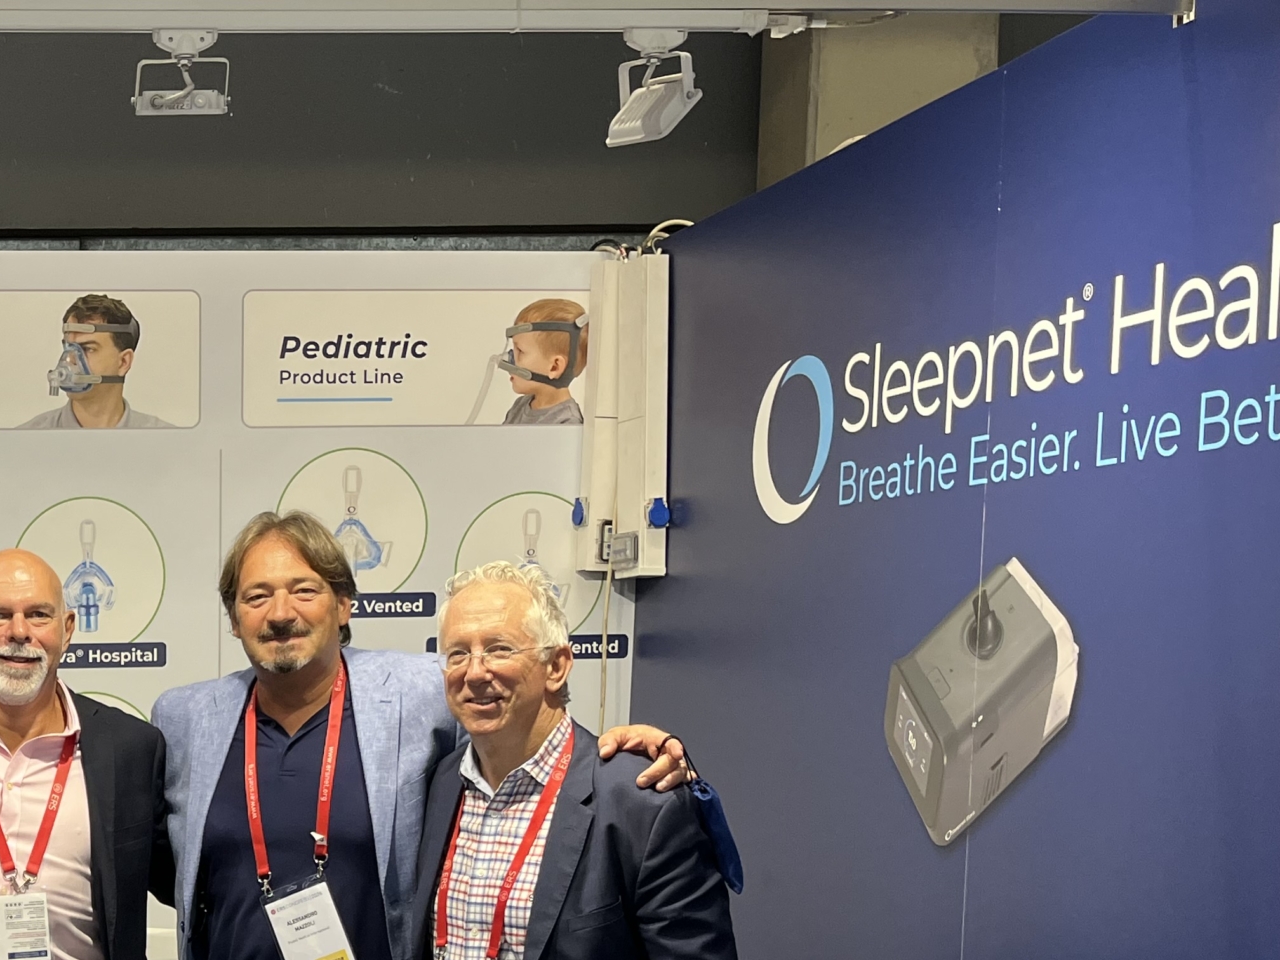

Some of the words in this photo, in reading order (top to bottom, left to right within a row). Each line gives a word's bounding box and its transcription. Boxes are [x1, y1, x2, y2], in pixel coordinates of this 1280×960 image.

[279, 333, 429, 361] Pediatric
[279, 368, 357, 385] Product
[363, 368, 404, 385] Line
[838, 444, 958, 506] Breathe
[968, 422, 1081, 487] Easier.
[1096, 403, 1181, 469] Live
[363, 598, 423, 613] Vented
[88, 648, 158, 665] Hospital
[557, 752, 572, 771] ERS
[48, 794, 60, 811] ERS
[504, 870, 517, 889] ERS
